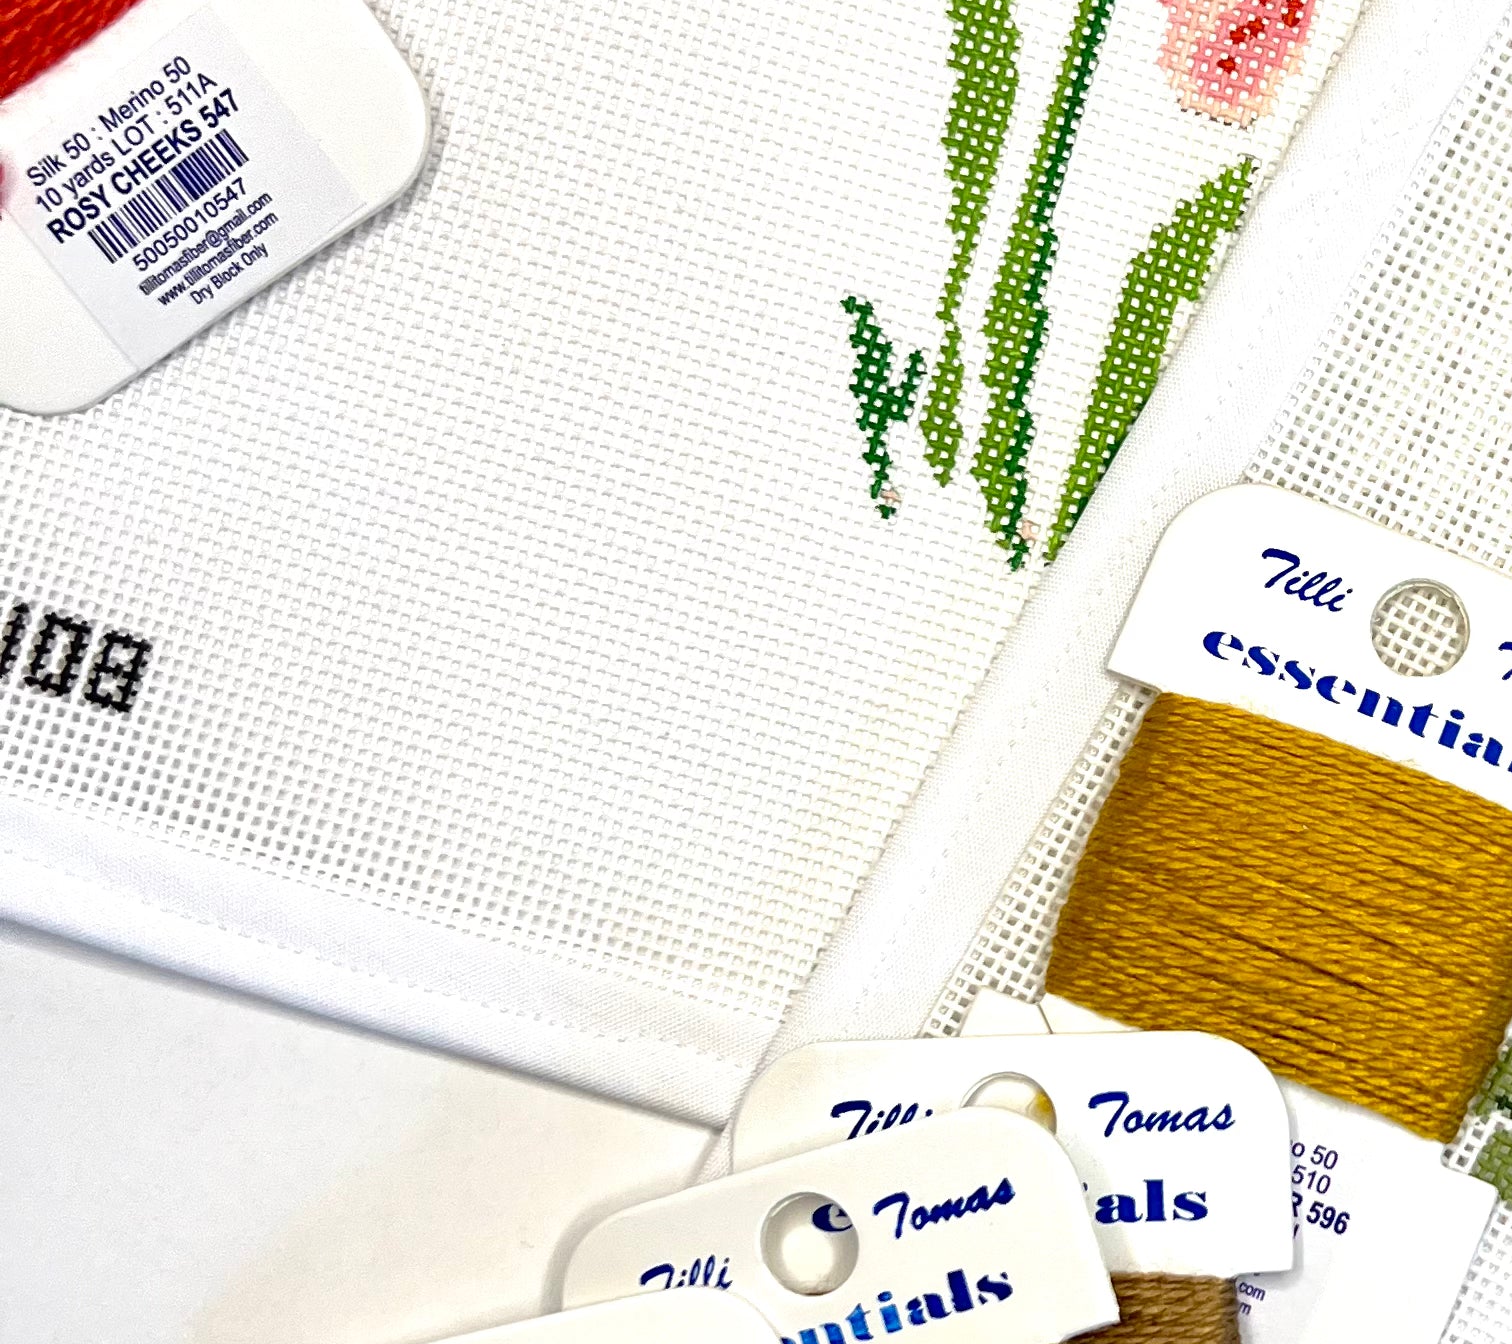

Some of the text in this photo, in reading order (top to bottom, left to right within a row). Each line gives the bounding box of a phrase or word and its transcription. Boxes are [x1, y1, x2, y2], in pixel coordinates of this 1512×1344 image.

[26, 56, 192, 187] Silk 50 Merino 50
[36, 74, 219, 213] 10 yards LOT 511A
[47, 87, 238, 245] ROSY CHEEKS 547
[132, 176, 247, 272] 50050010547
[189, 243, 269, 305] Dry Block Only
[1262, 548, 1353, 612] Tilli
[1088, 1090, 1236, 1138] Tomas
[1310, 1143, 1339, 1171] 50
[872, 1177, 1016, 1239] Tomas
[1306, 1200, 1351, 1235] 596
